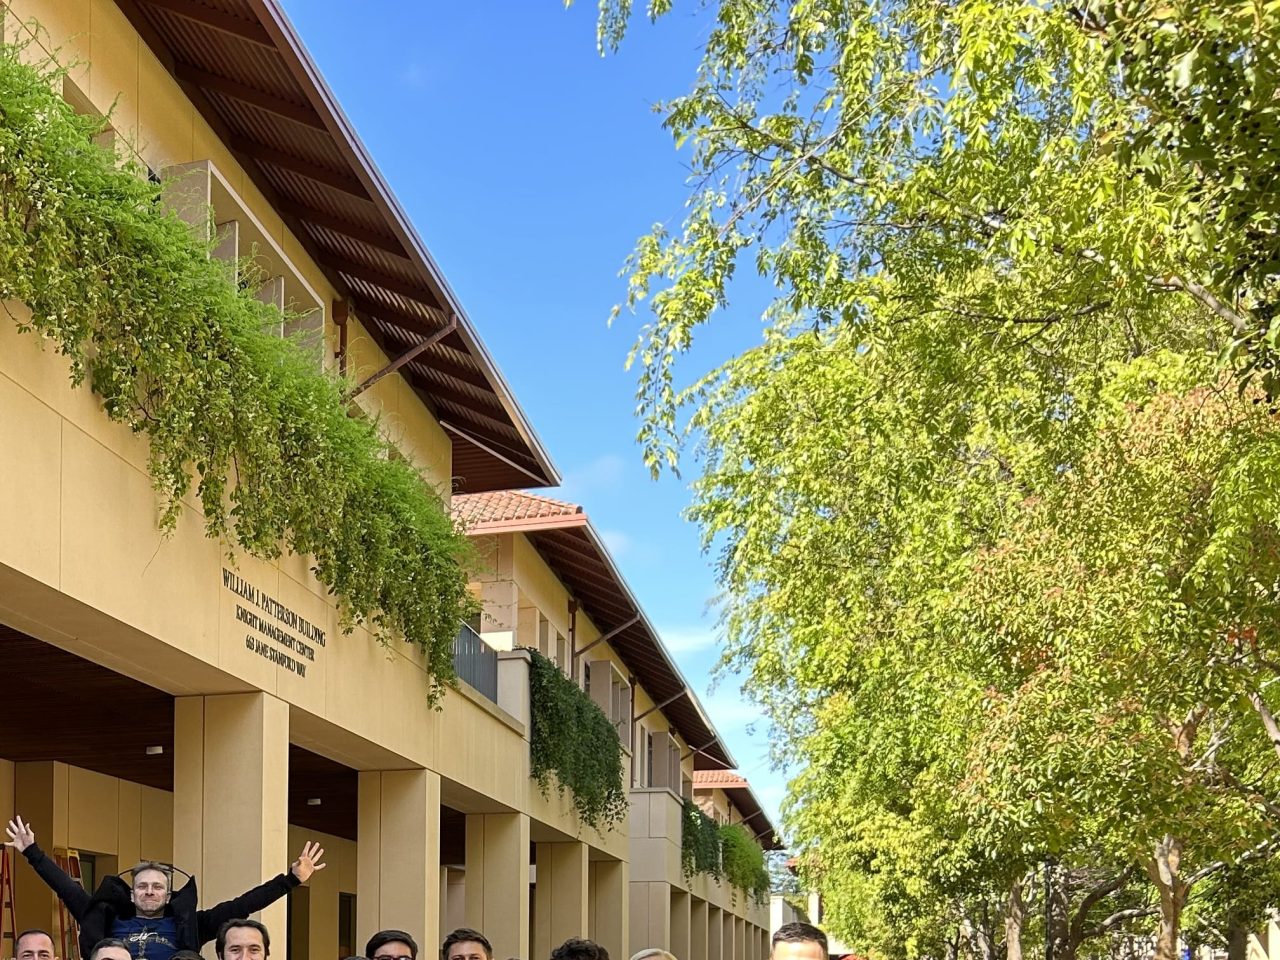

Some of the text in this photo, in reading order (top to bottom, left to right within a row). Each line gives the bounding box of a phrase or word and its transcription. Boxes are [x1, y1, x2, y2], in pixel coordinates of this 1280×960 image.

[222, 567, 255, 604] WILLIAM
[261, 592, 298, 629] PATTERSON
[298, 616, 326, 648] BUILDING
[236, 604, 315, 662] KNIGHT MANAGEMENT CENTER
[255, 639, 268, 659] JANE
[268, 646, 296, 672] STANFORD
